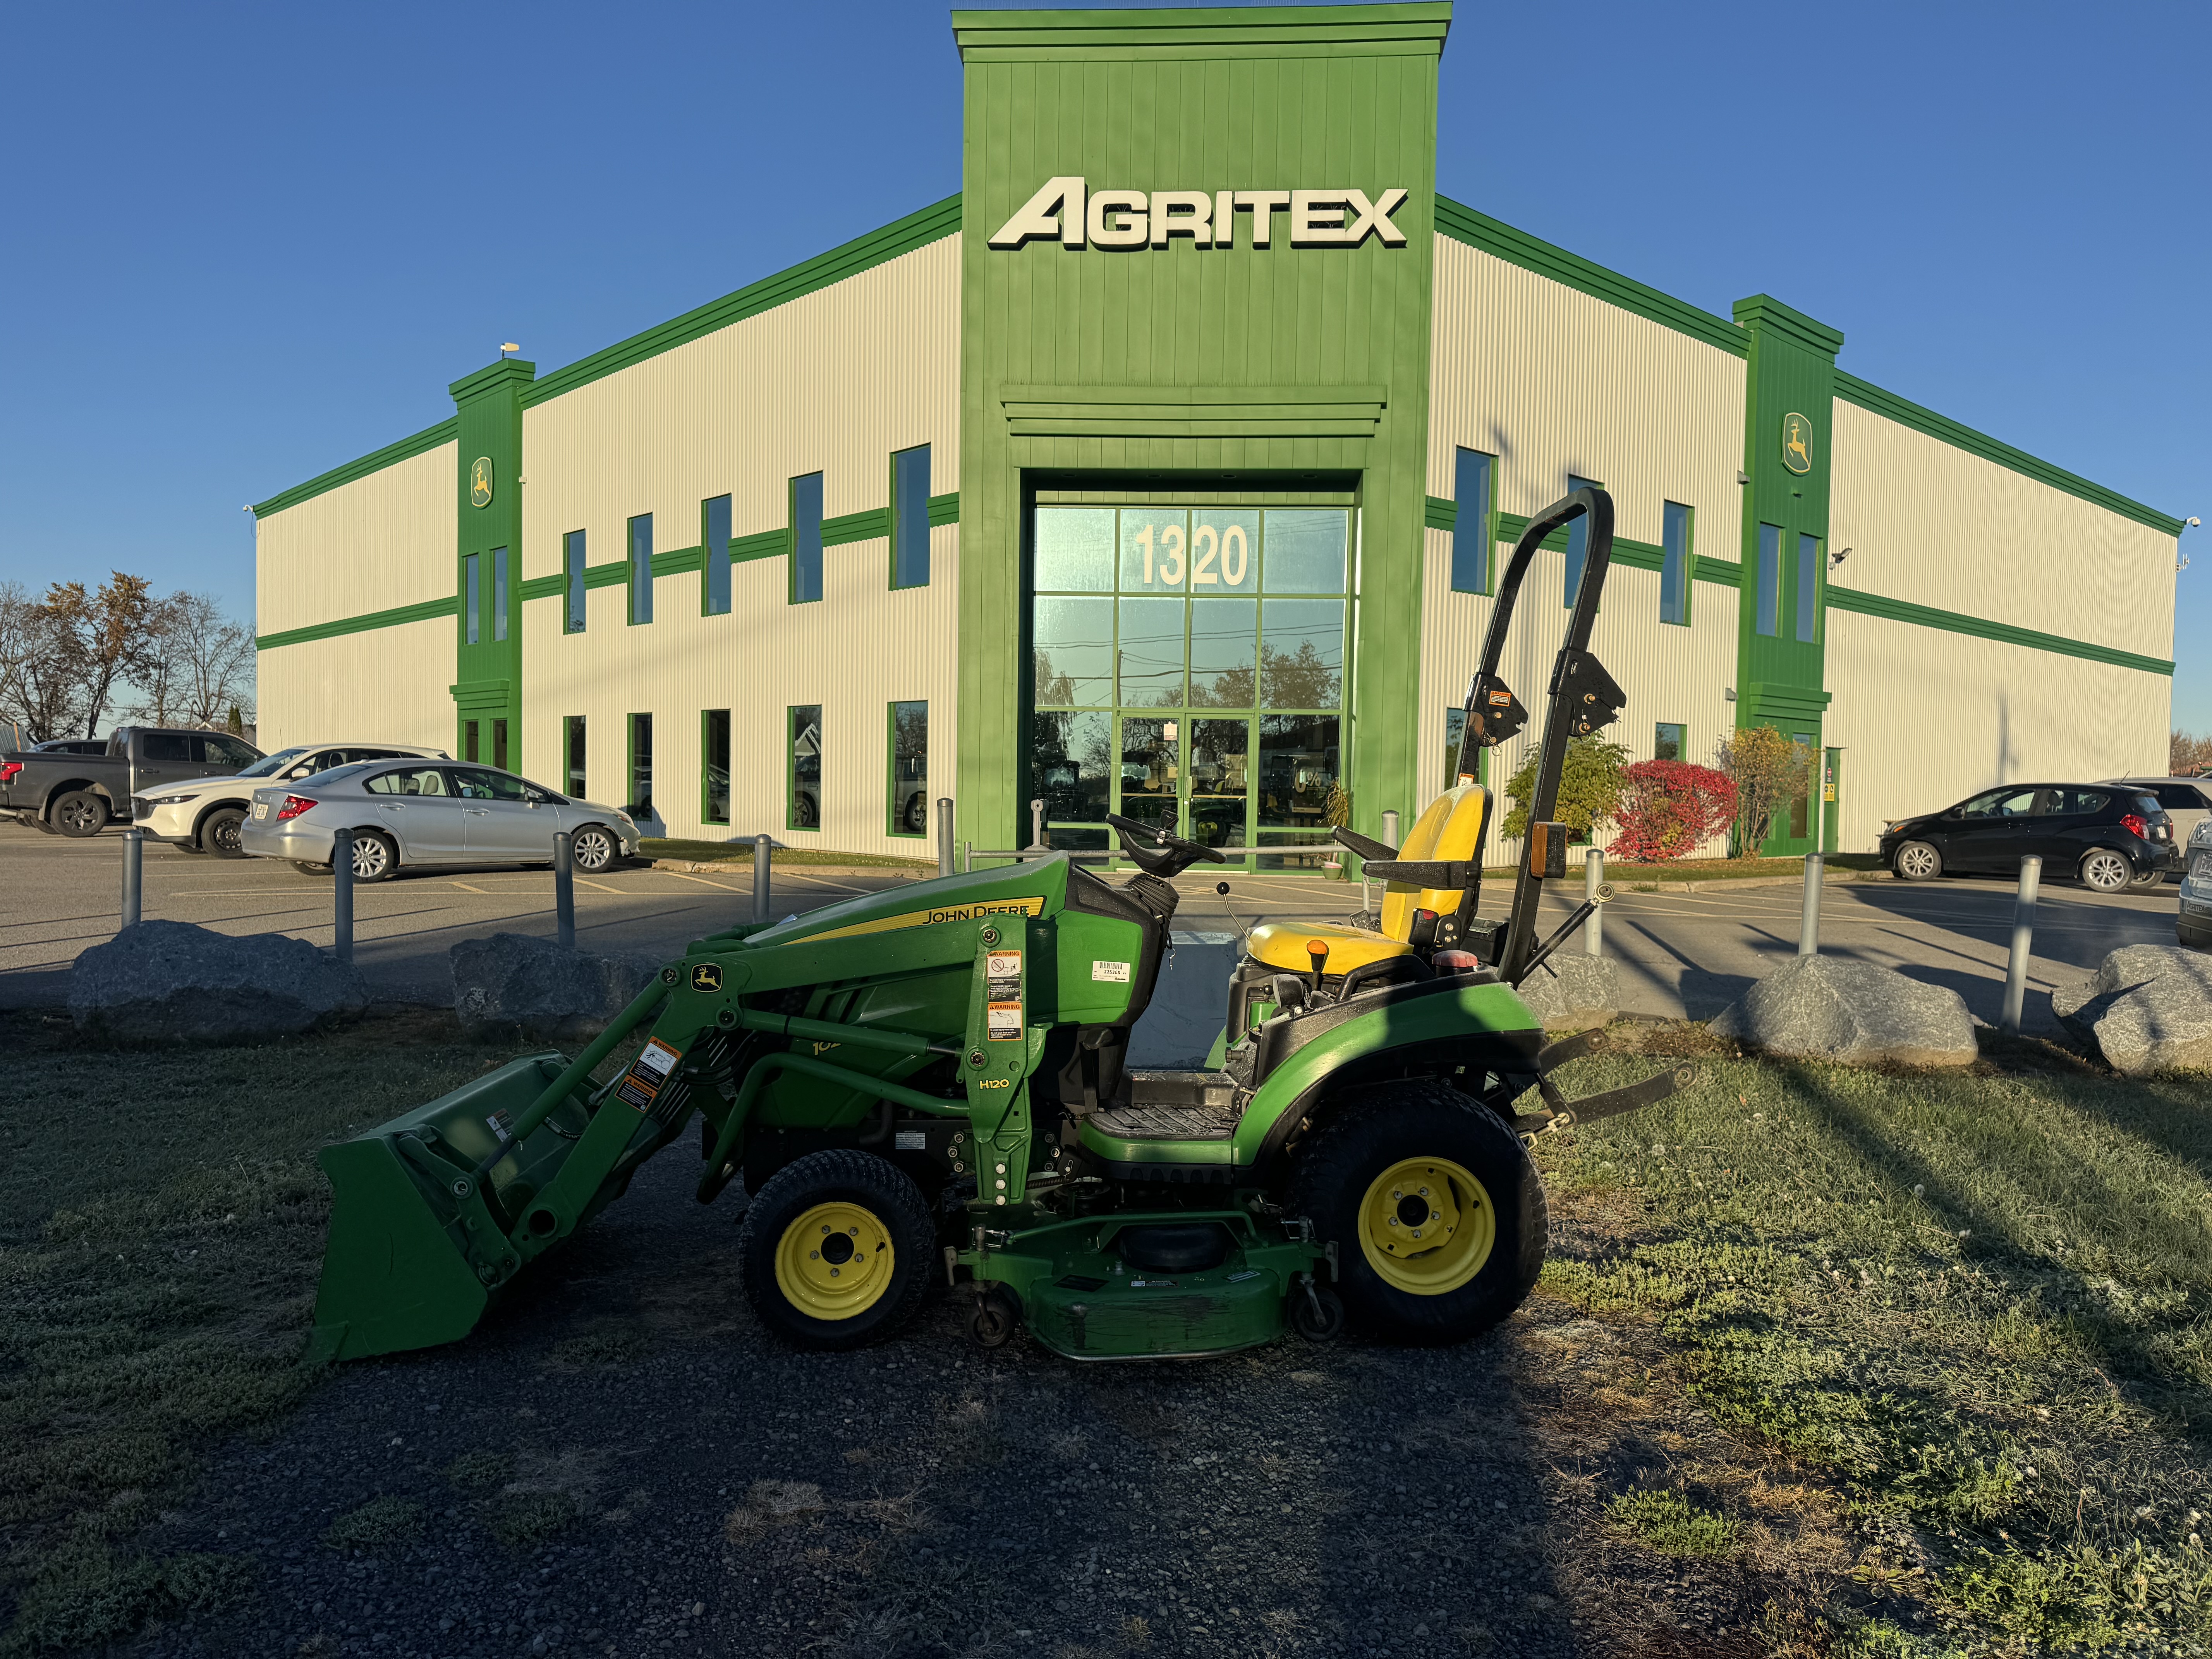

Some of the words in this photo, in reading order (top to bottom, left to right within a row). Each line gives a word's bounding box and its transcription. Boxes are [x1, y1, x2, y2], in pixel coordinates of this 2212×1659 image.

[987, 176, 1409, 250] AGRITEX
[1136, 524, 1248, 586] 1320
[922, 909, 969, 925] JOHN
[979, 1079, 1010, 1089] H120
